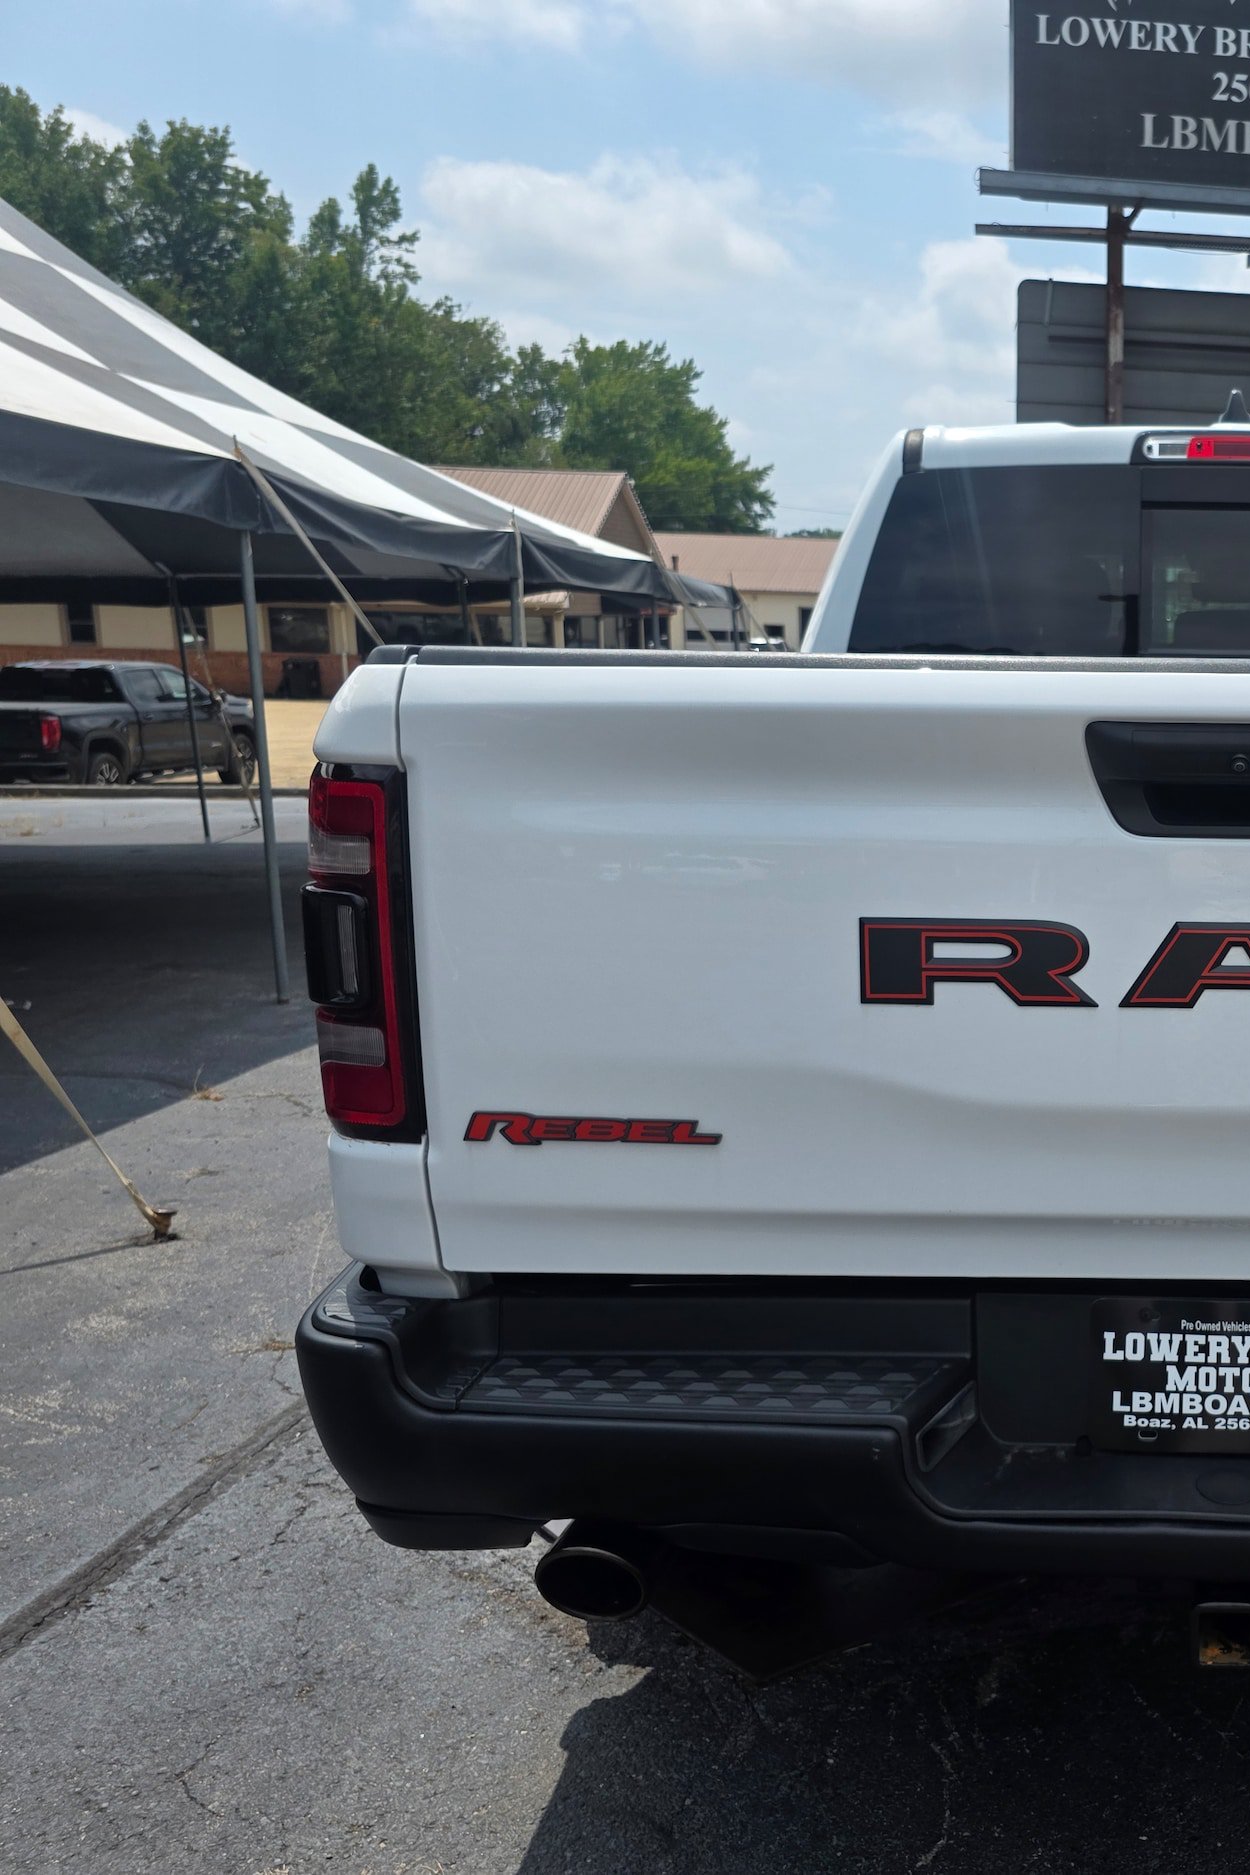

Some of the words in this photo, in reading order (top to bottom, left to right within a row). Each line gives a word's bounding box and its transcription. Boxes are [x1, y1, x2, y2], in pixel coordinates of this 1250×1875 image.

[1035, 14, 1206, 54] LOWERY
[1181, 1320, 1194, 1330] Pre
[1195, 1321, 1220, 1331] Owned
[1123, 1415, 1176, 1430] Boaz,
[1182, 1416, 1209, 1429] AL
